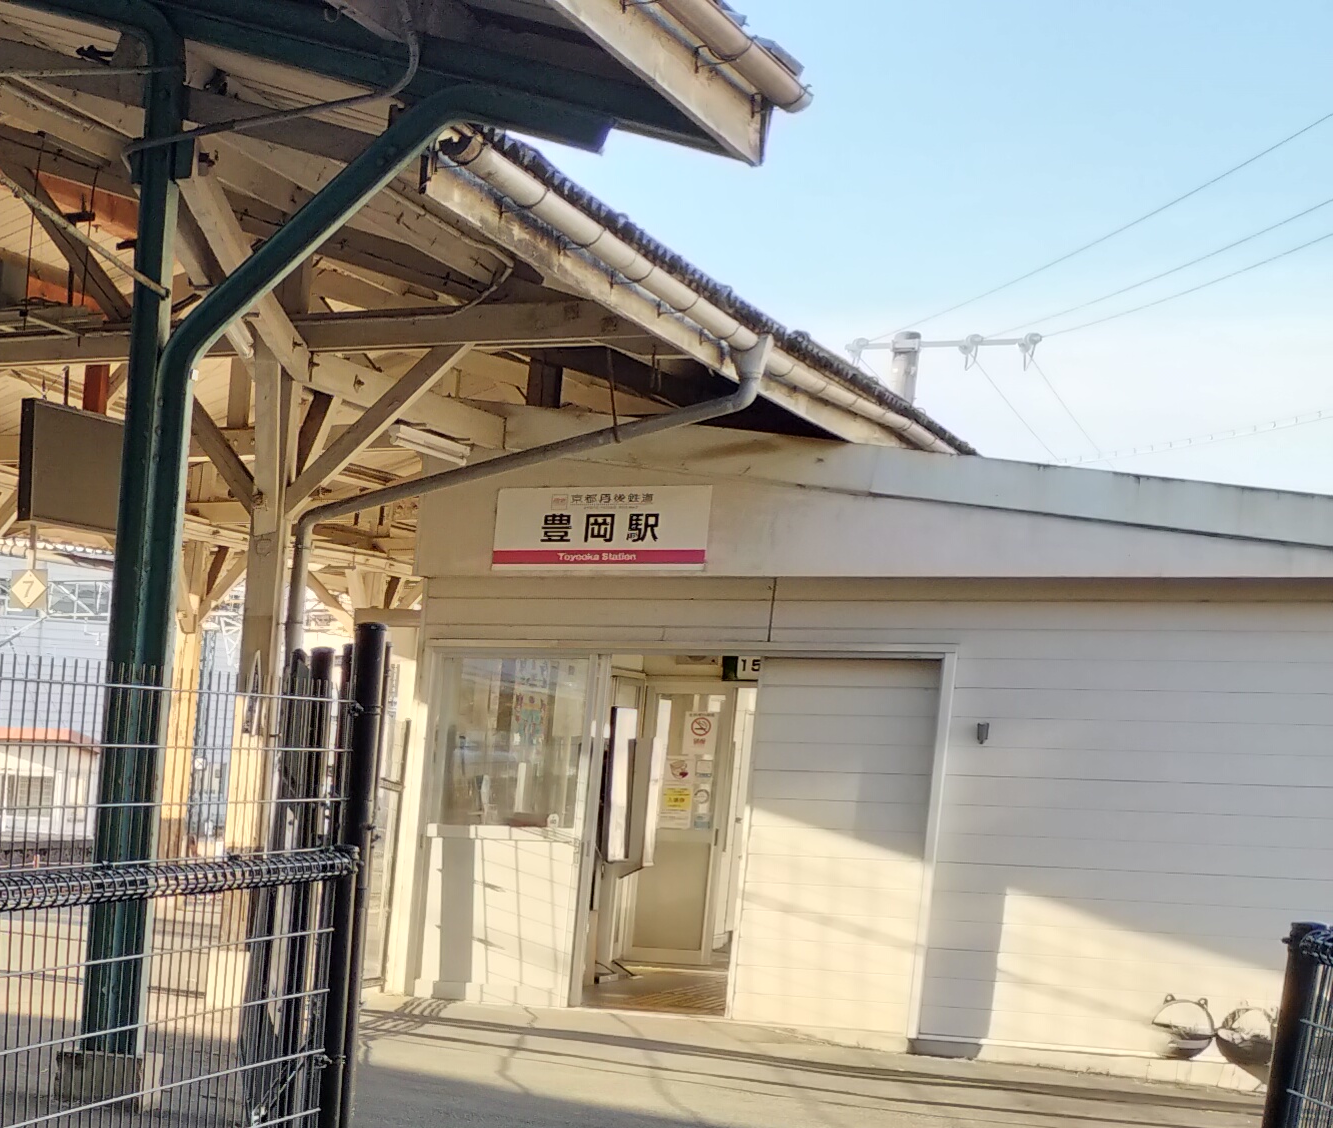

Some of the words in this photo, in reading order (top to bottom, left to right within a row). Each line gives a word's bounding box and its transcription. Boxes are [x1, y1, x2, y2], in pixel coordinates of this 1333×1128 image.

[570, 493, 654, 505] 京都丹後鉄道
[540, 513, 660, 543] 豊岡駅
[557, 552, 600, 562] Toyooka
[601, 551, 637, 561] Station
[22, 580, 35, 598] 7
